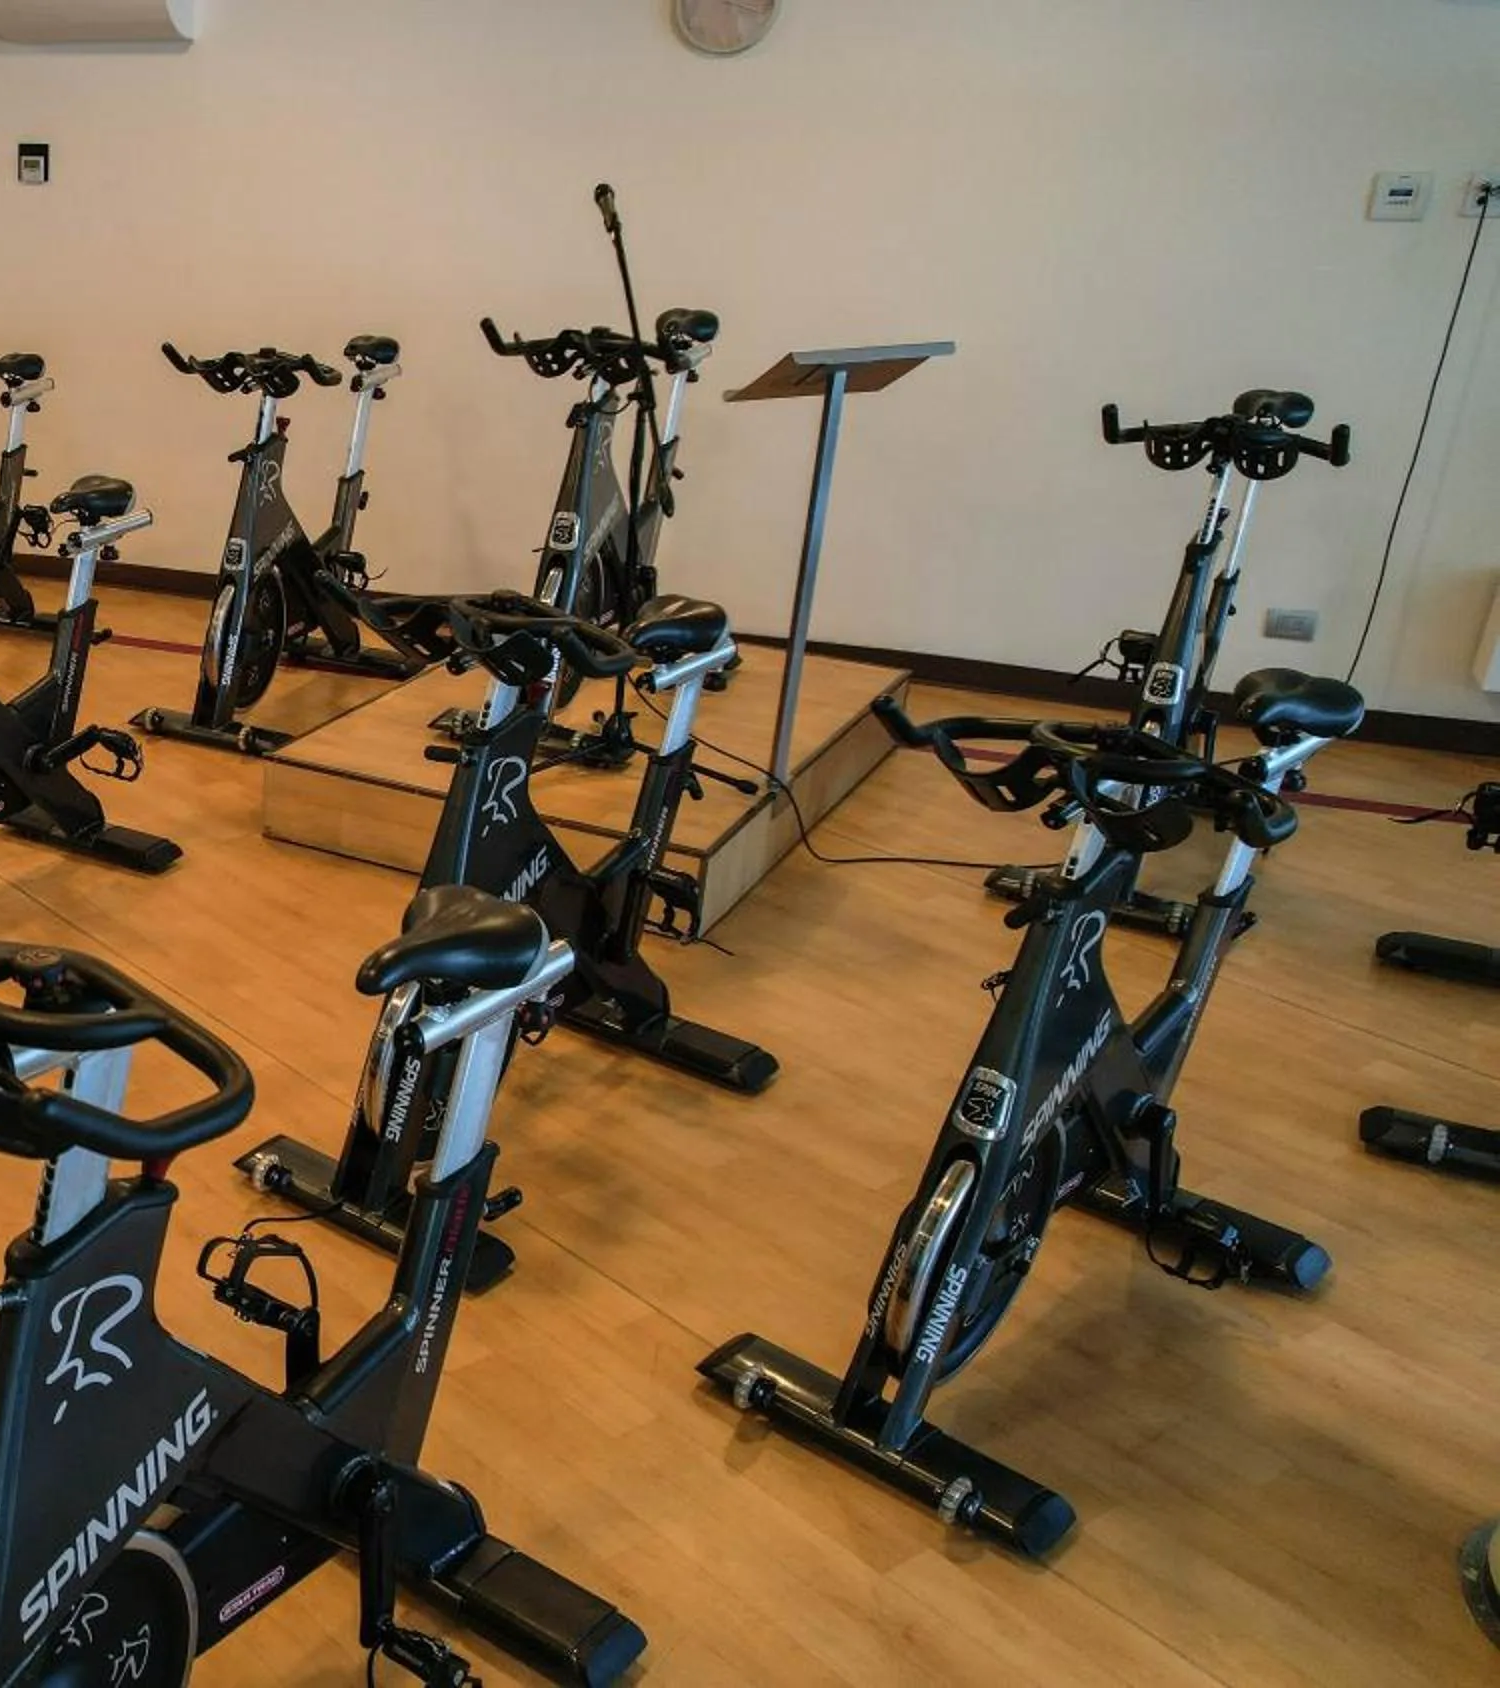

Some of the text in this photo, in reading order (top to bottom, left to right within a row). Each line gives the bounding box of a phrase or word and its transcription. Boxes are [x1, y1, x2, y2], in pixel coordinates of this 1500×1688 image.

[386, 1056, 421, 1144] SPINNING
[1019, 1007, 1113, 1161] SPINNING
[414, 1256, 453, 1375] SPINNER
[915, 1263, 968, 1364] SPINNING
[20, 1387, 218, 1644] SPINNING
